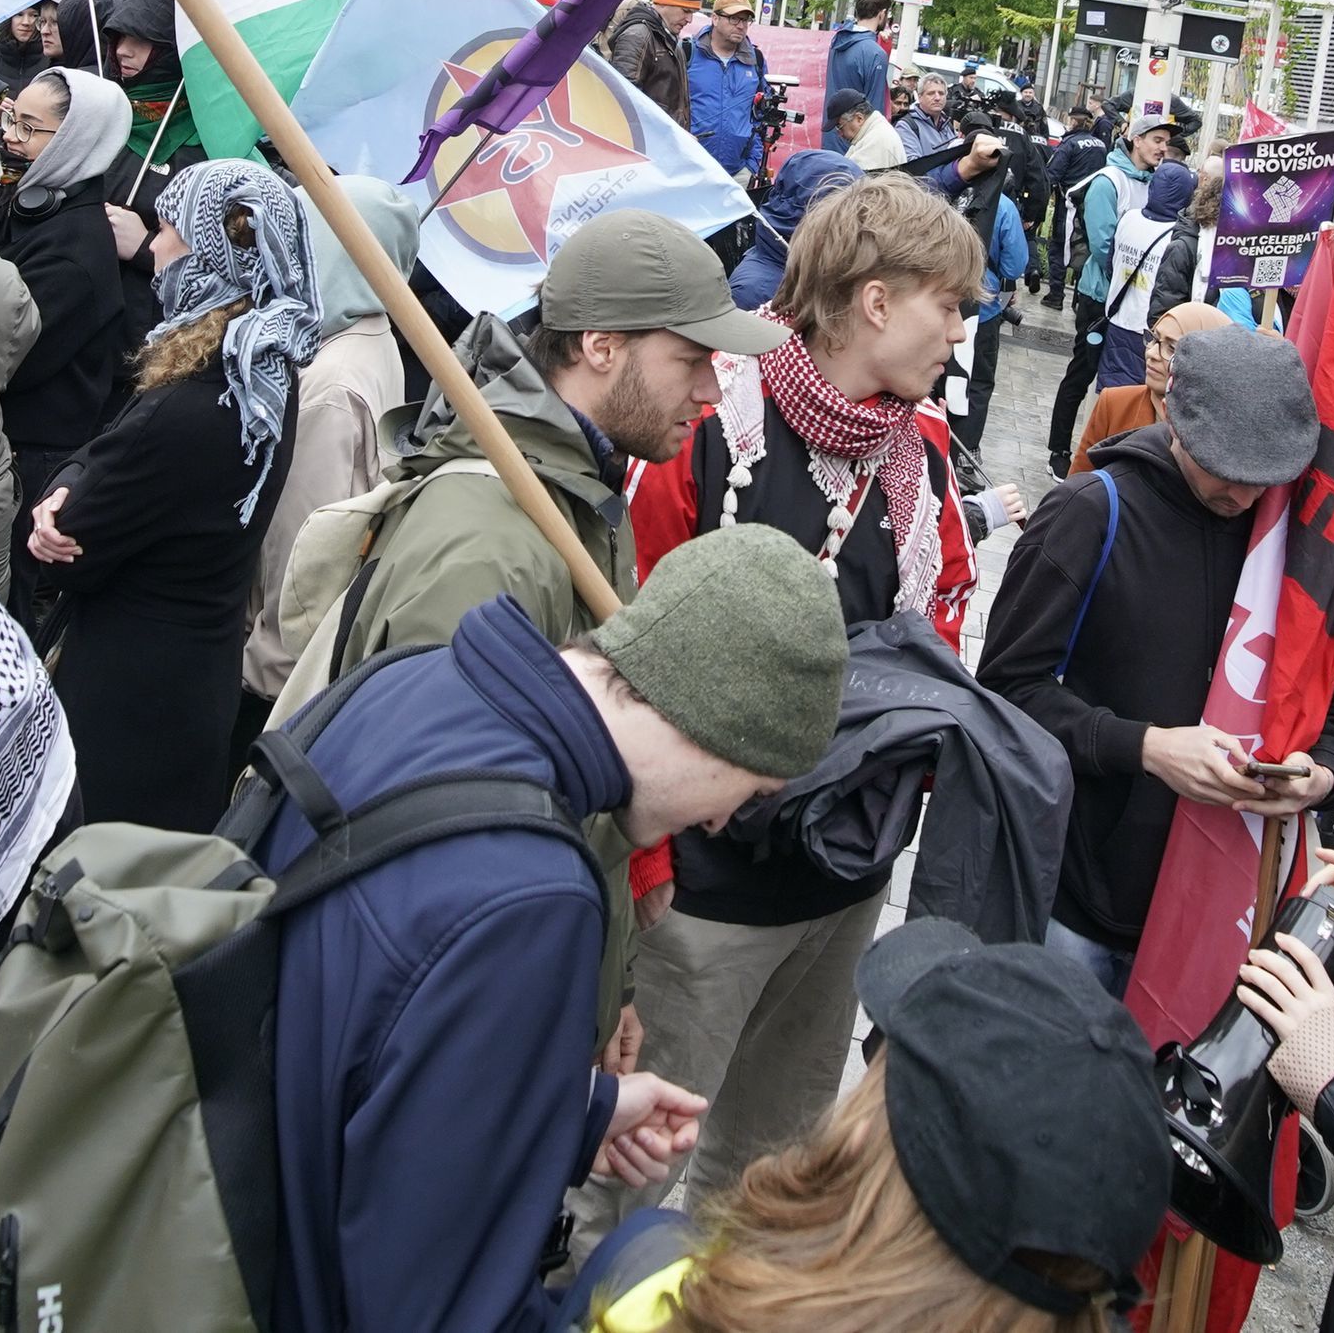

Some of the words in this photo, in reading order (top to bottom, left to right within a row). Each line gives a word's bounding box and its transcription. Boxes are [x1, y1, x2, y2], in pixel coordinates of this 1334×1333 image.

[1257, 142, 1317, 159] BLOCK
[1216, 236, 1259, 246] DON'T
[1259, 231, 1318, 245] CELEBRAT
[1238, 244, 1303, 256] GENOCIDE
[1122, 254, 1154, 273] OBSEVER
